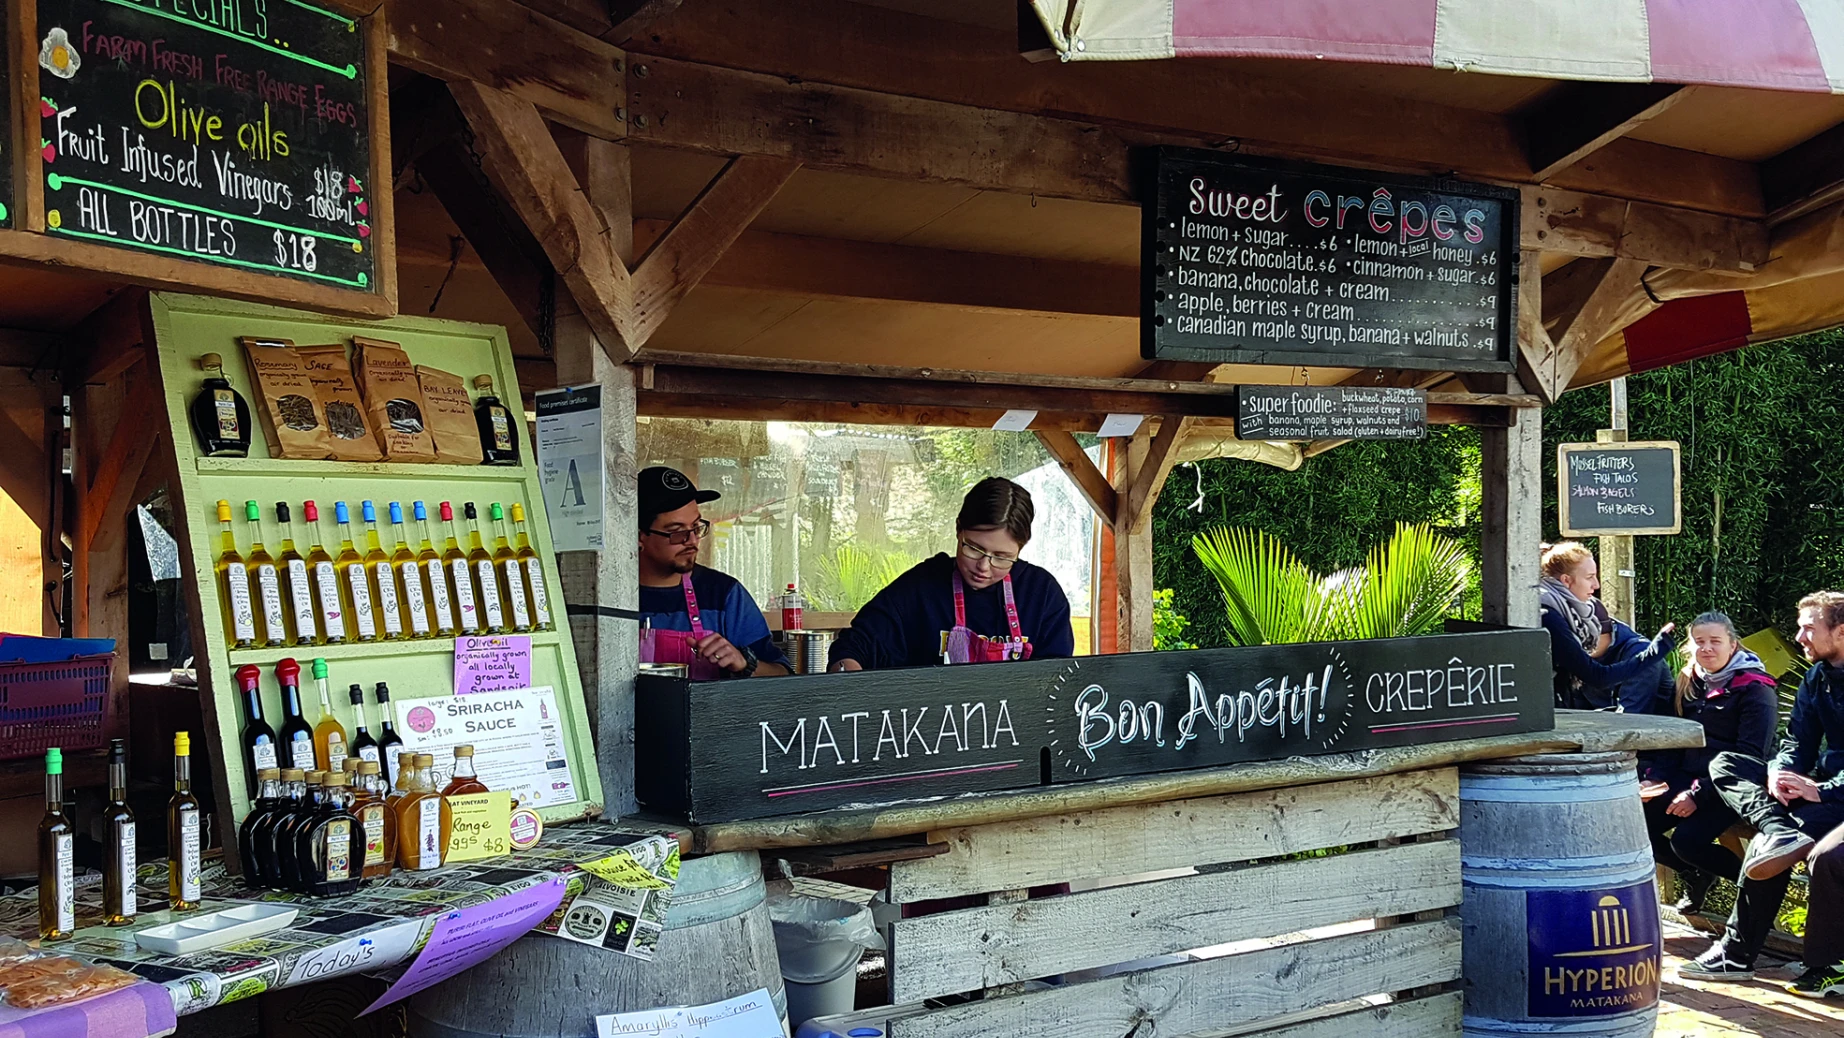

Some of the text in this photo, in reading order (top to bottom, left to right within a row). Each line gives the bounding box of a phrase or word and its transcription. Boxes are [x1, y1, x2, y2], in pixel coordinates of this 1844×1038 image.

[152, 38, 203, 80] FRESH
[257, 69, 309, 109] RANGE
[315, 84, 357, 128] EGGS
[135, 79, 224, 146] Olive
[121, 126, 202, 190] Infused
[212, 150, 293, 216] Vinegars
[1189, 176, 1486, 245] Sweet crêpes
[77, 187, 318, 273] ALL BOTTLES $18
[1181, 216, 1229, 241] lemon
[1179, 245, 1201, 262] NZ
[1207, 245, 1239, 267] 62%
[1354, 234, 1398, 257] lemon
[1409, 240, 1429, 255] local
[1432, 242, 1473, 266] honey
[1481, 252, 1497, 266] $6
[1353, 256, 1424, 281] cinnamon
[1232, 294, 1288, 316] berries
[1177, 315, 1246, 337] canadian
[1252, 320, 1296, 342] maple
[1301, 323, 1346, 346] syrup,
[1349, 324, 1400, 345] banana
[1413, 328, 1469, 348] walnuts
[1242, 414, 1400, 429] with banana, maple syrup, walnuts and
[1348, 403, 1379, 415] flaxseed
[1269, 426, 1308, 436] seasonal
[1310, 425, 1330, 438] fruit
[1332, 426, 1353, 436] salad
[560, 458, 587, 508] A
[468, 661, 515, 674] all locally
[502, 650, 527, 662] grown
[475, 672, 520, 686] grown at
[447, 699, 524, 717] SRIRACHA
[759, 656, 1518, 774] MATAKANA Bon Appétit! CREPÊRIE
[465, 717, 517, 733] SAUCE
[450, 835, 504, 853] ggs $8
[300, 947, 375, 979] Today's
[1544, 955, 1657, 996] HYPERION
[1570, 991, 1644, 1008] MATAKANA
